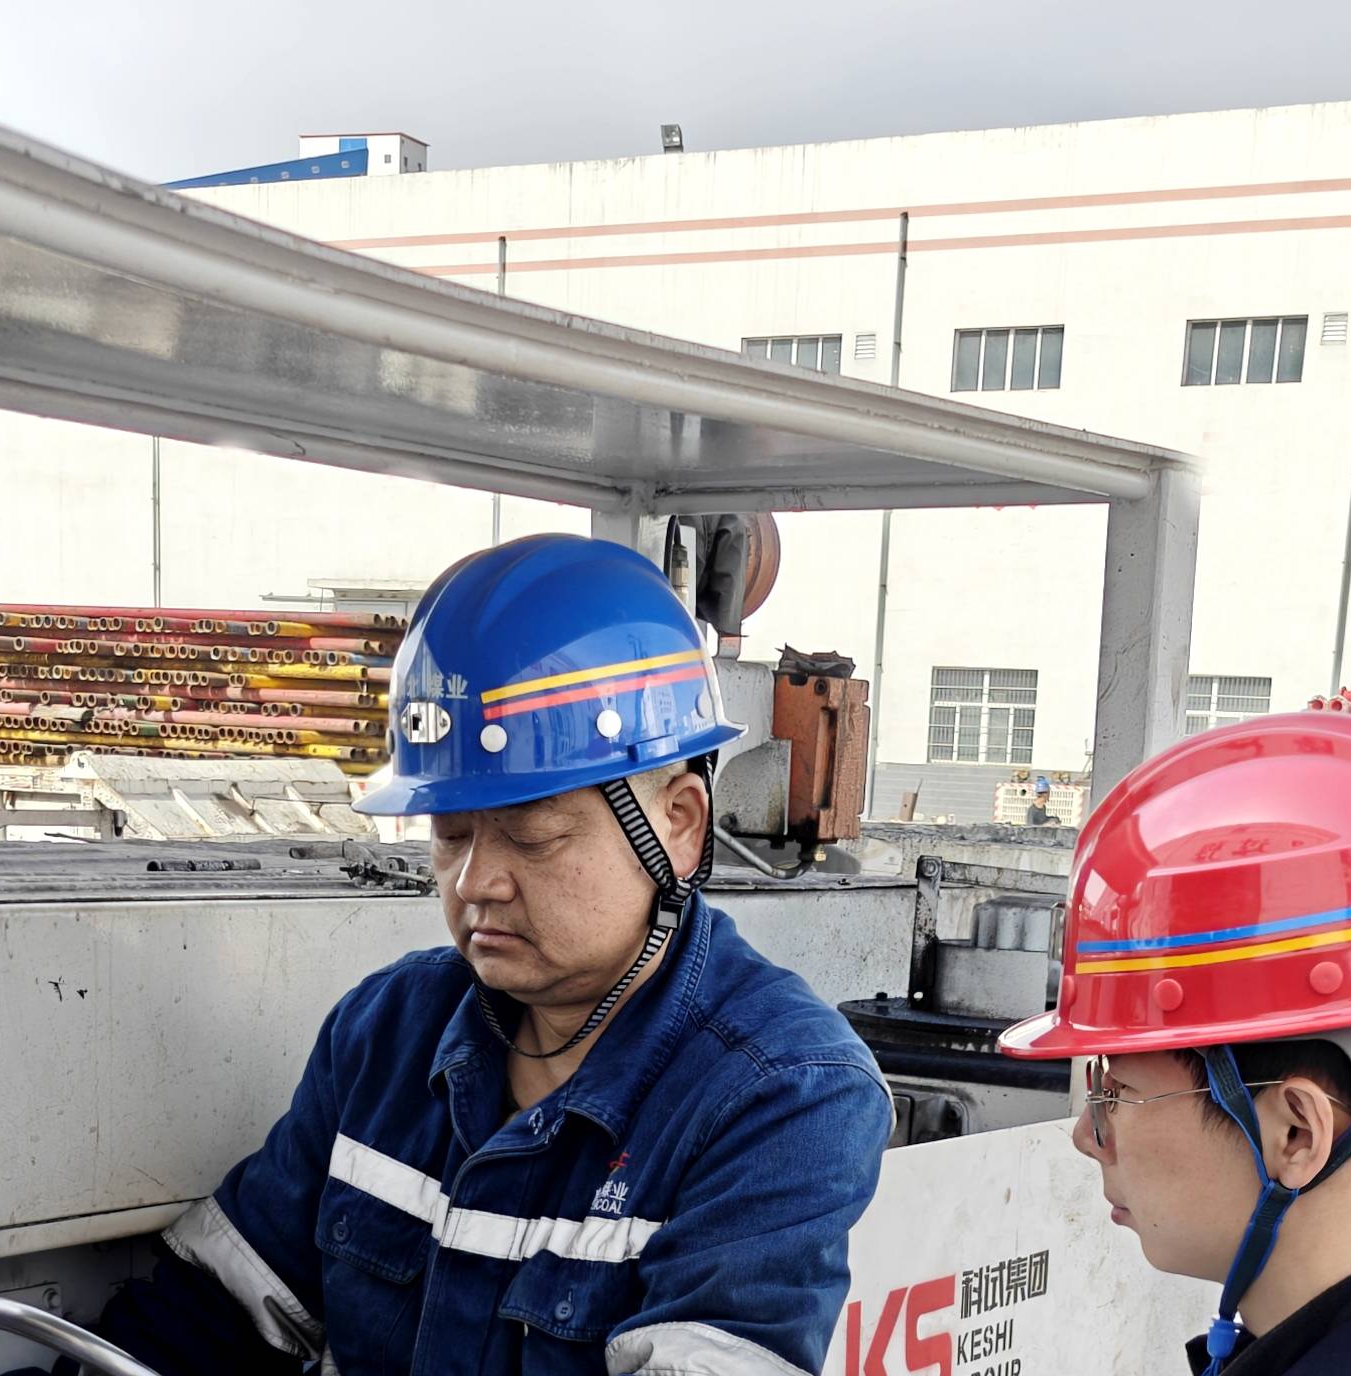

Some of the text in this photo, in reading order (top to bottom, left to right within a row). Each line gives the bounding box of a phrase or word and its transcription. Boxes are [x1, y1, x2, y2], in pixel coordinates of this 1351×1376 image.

[961, 1249, 1050, 1320] 科试集团
[956, 1318, 1014, 1366] KESHI
